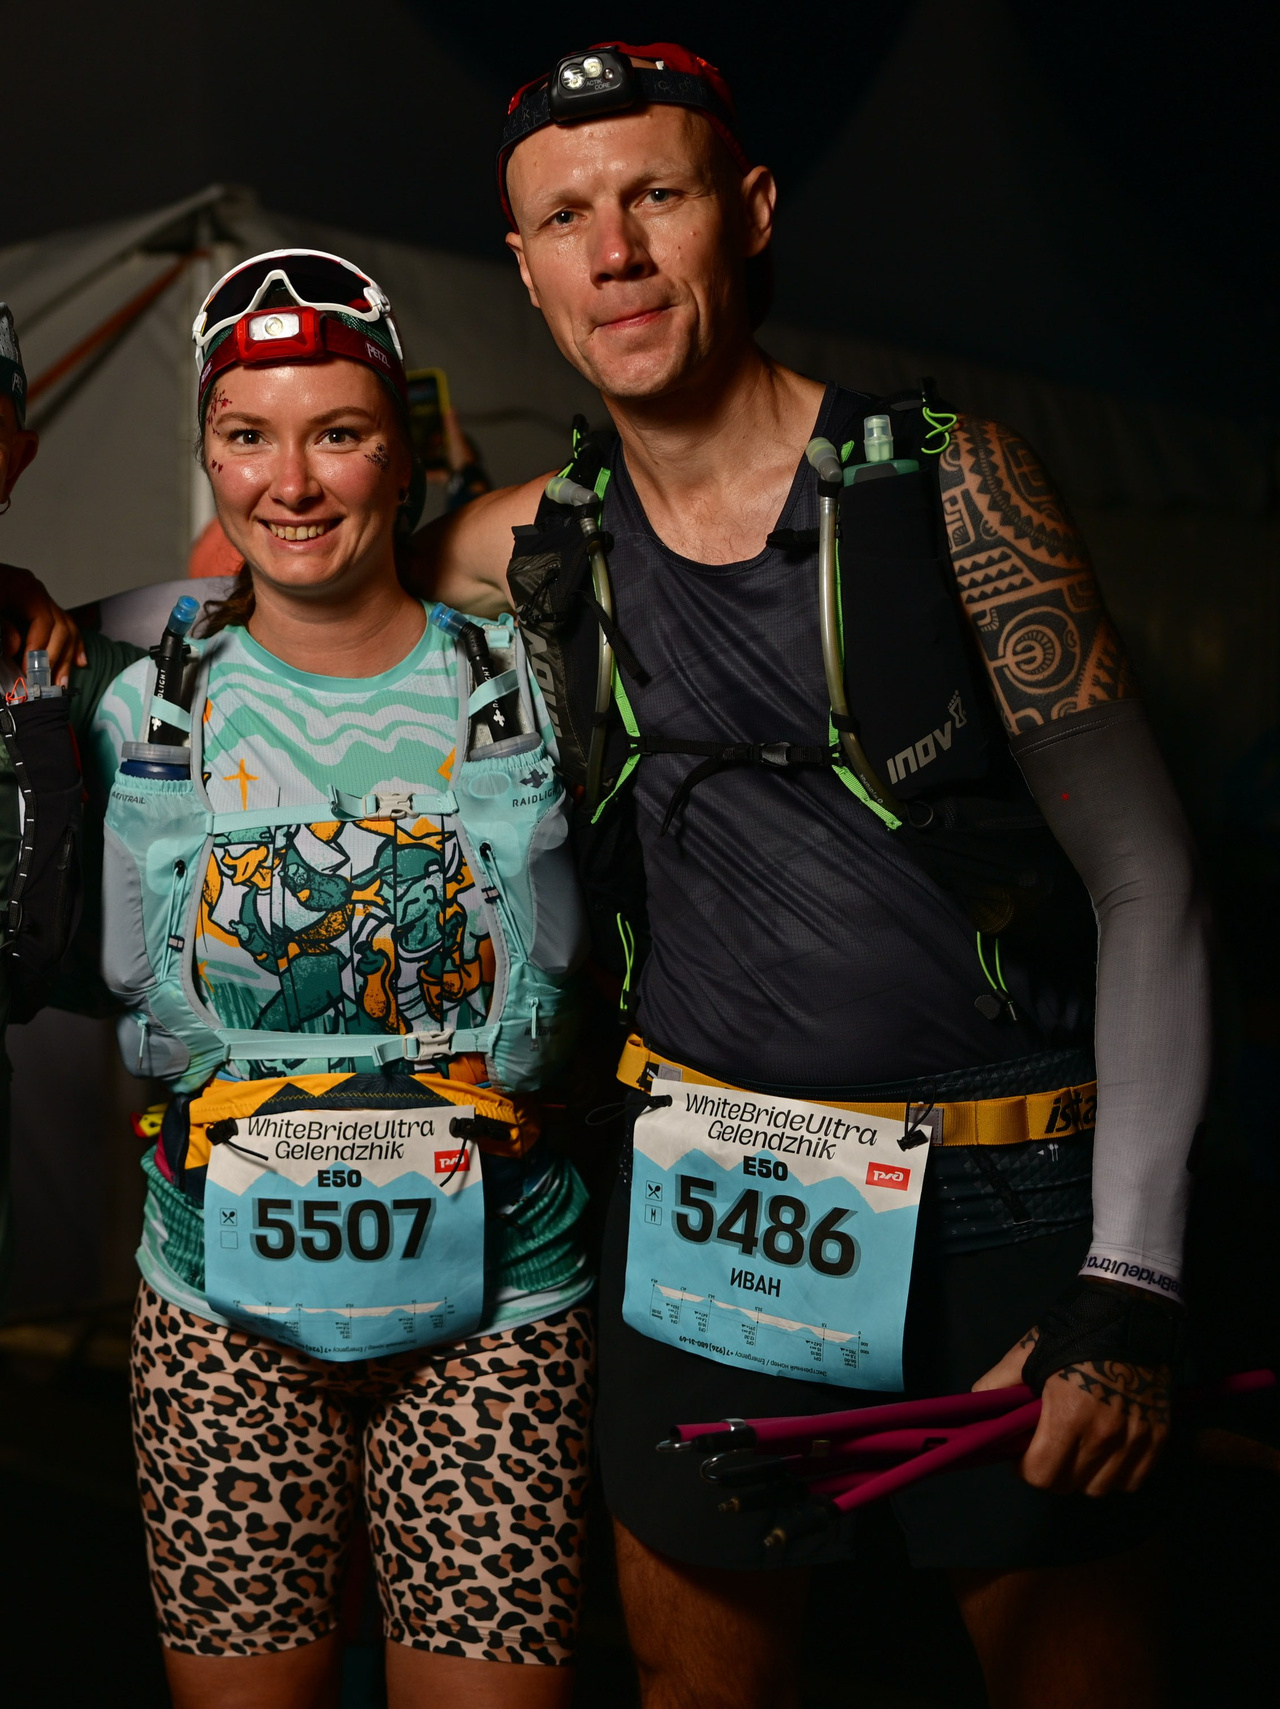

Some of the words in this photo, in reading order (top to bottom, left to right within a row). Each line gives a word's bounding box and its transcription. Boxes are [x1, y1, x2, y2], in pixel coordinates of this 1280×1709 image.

[247, 1117, 435, 1141] WhiteBrideUltra
[685, 1092, 878, 1146] WhiteBrideUltra
[274, 1140, 405, 1161] Gelendzhik
[708, 1121, 837, 1161] Gelendzhik
[316, 1169, 362, 1188] E50
[743, 1155, 789, 1182] E50
[253, 1197, 433, 1261] 5507
[674, 1174, 856, 1277] 5486
[730, 1267, 781, 1297] ИВАН
